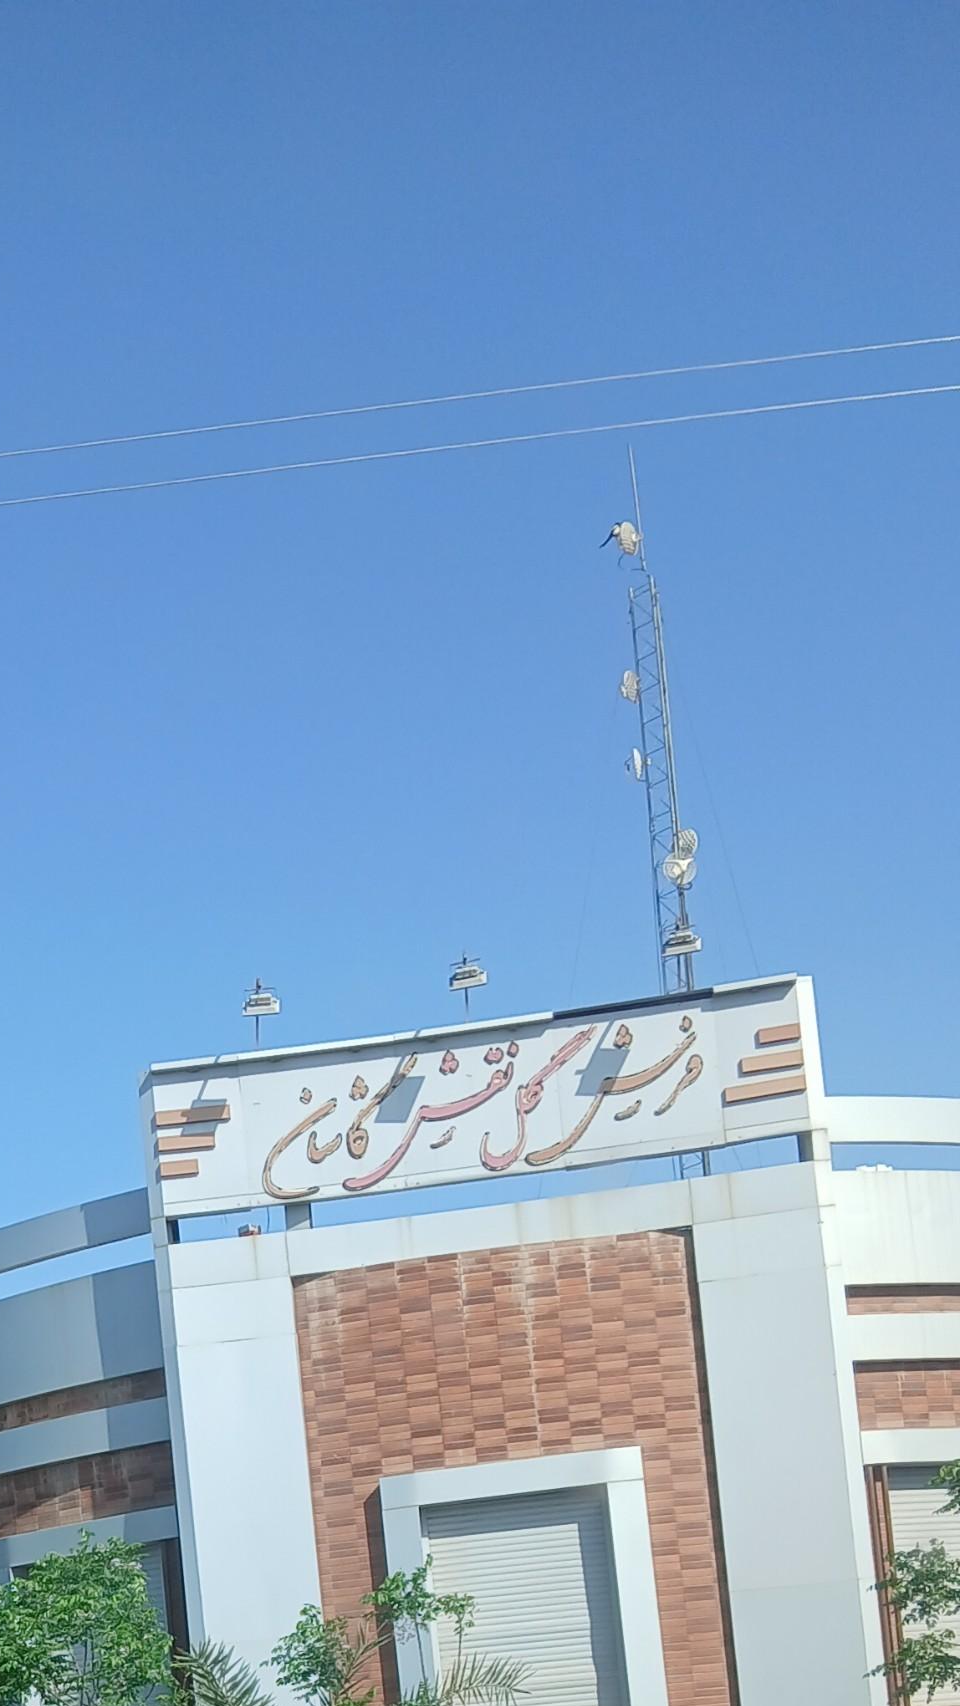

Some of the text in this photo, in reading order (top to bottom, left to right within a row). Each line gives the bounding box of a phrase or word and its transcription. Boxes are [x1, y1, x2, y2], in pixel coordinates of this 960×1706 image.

[262, 1015, 704, 1199] فرش گل نقش کاشان
